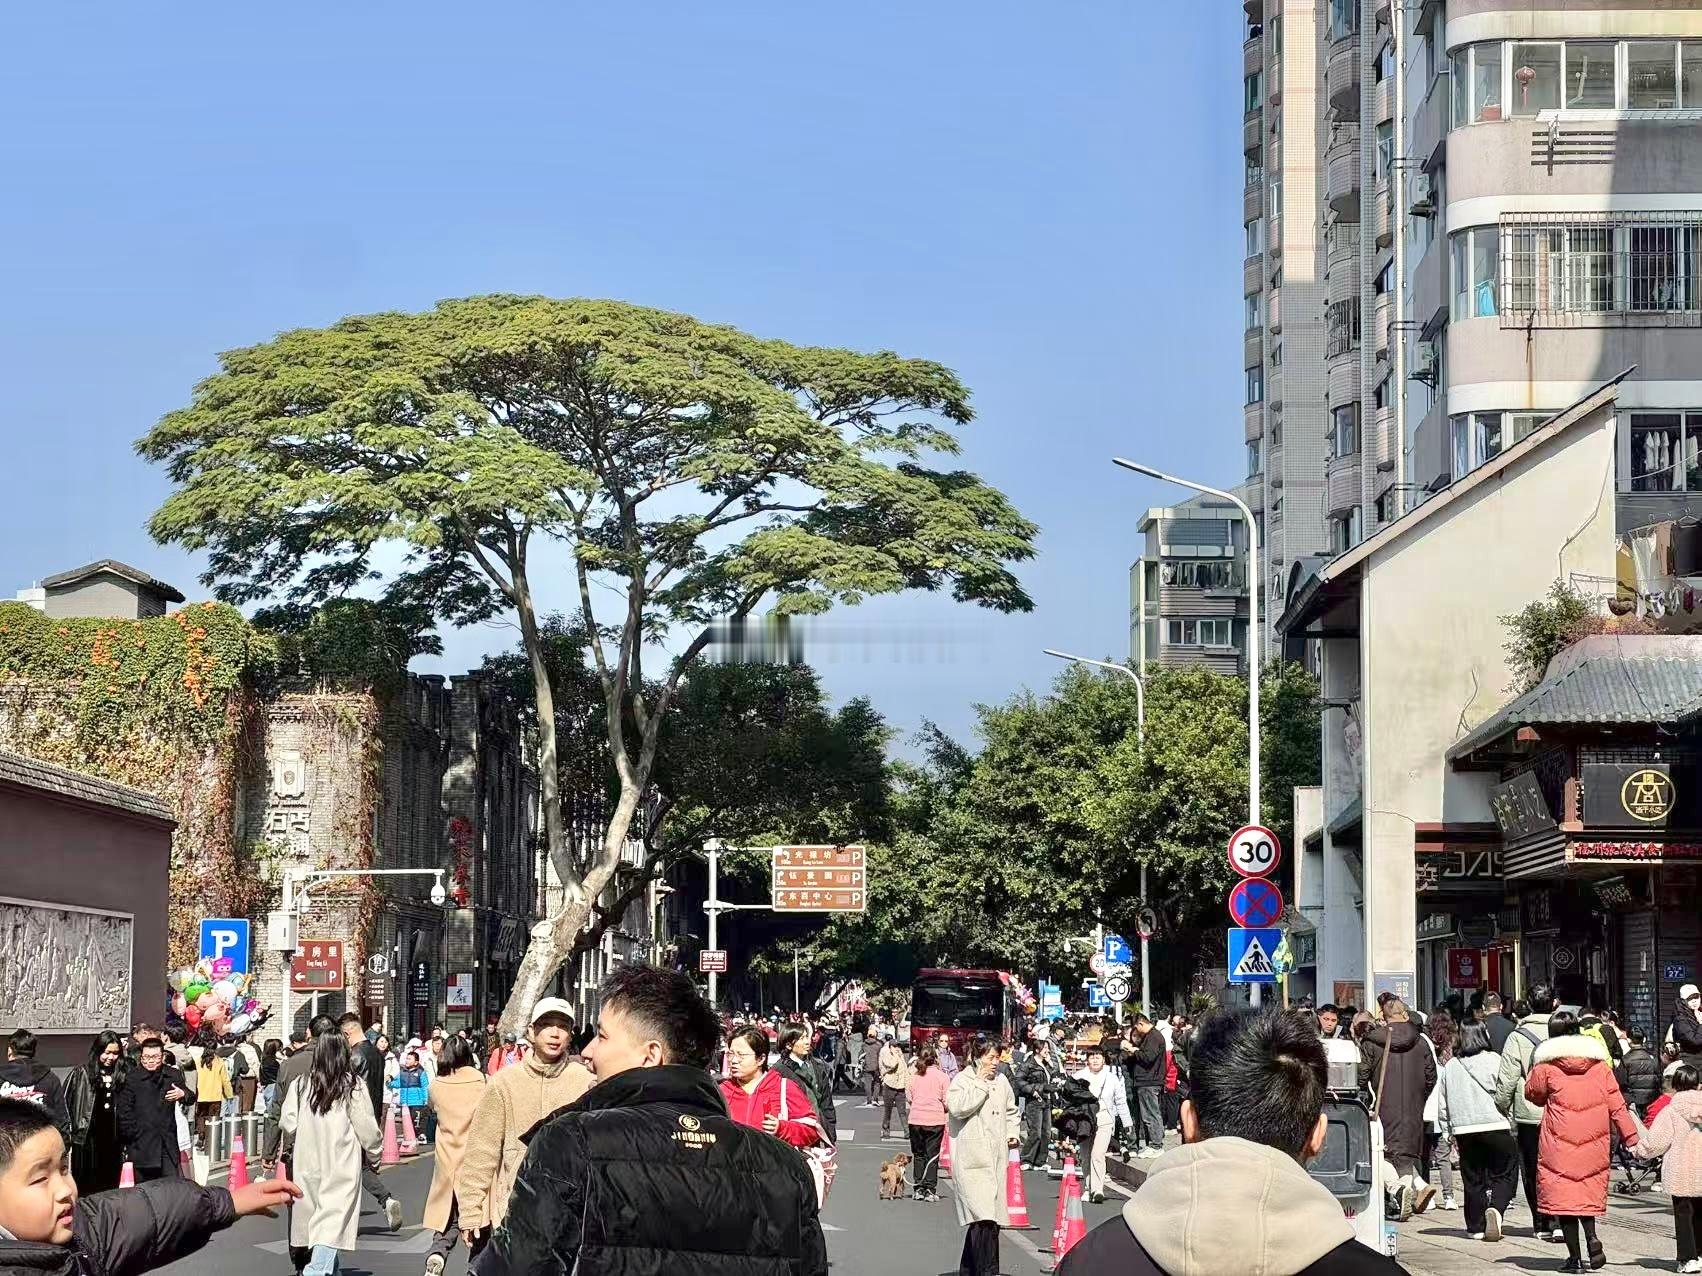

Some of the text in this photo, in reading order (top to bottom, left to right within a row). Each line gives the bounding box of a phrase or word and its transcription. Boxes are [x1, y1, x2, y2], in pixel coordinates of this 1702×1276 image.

[852, 851, 862, 864] P
[1239, 840, 1273, 864] 30
[852, 871, 861, 884] P
[852, 892, 861, 905] P
[211, 930, 238, 959] P
[1107, 940, 1121, 960] P
[329, 970, 337, 983] P
[1092, 987, 1104, 1004] P
[1109, 984, 1126, 995] 30
